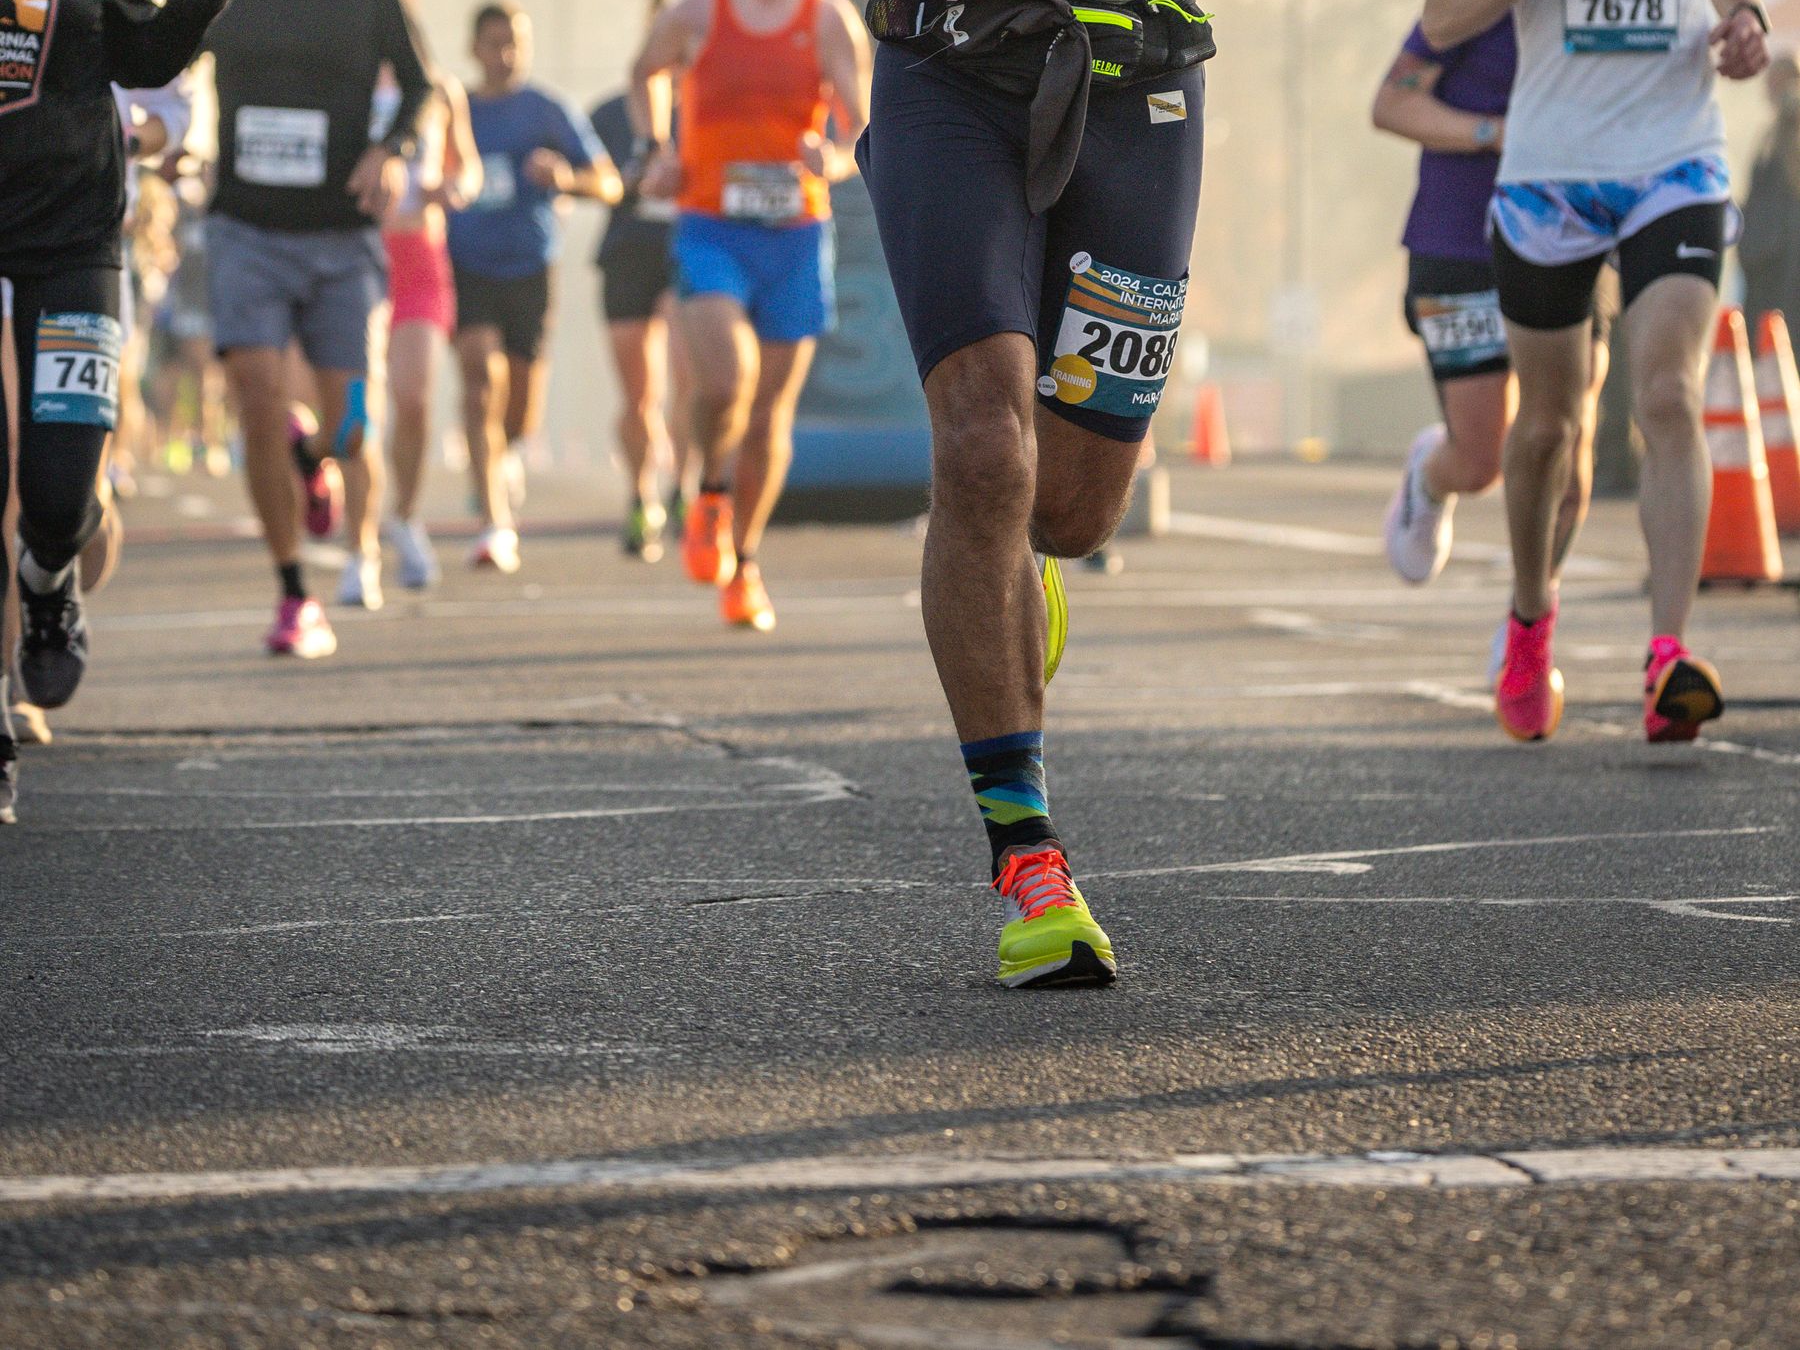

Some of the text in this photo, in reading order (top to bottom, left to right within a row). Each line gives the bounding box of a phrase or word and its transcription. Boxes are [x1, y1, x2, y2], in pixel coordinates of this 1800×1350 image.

[1100, 270, 1141, 292] 2024
[1077, 320, 1179, 378] 2088
[1052, 368, 1092, 390] TRAINING
